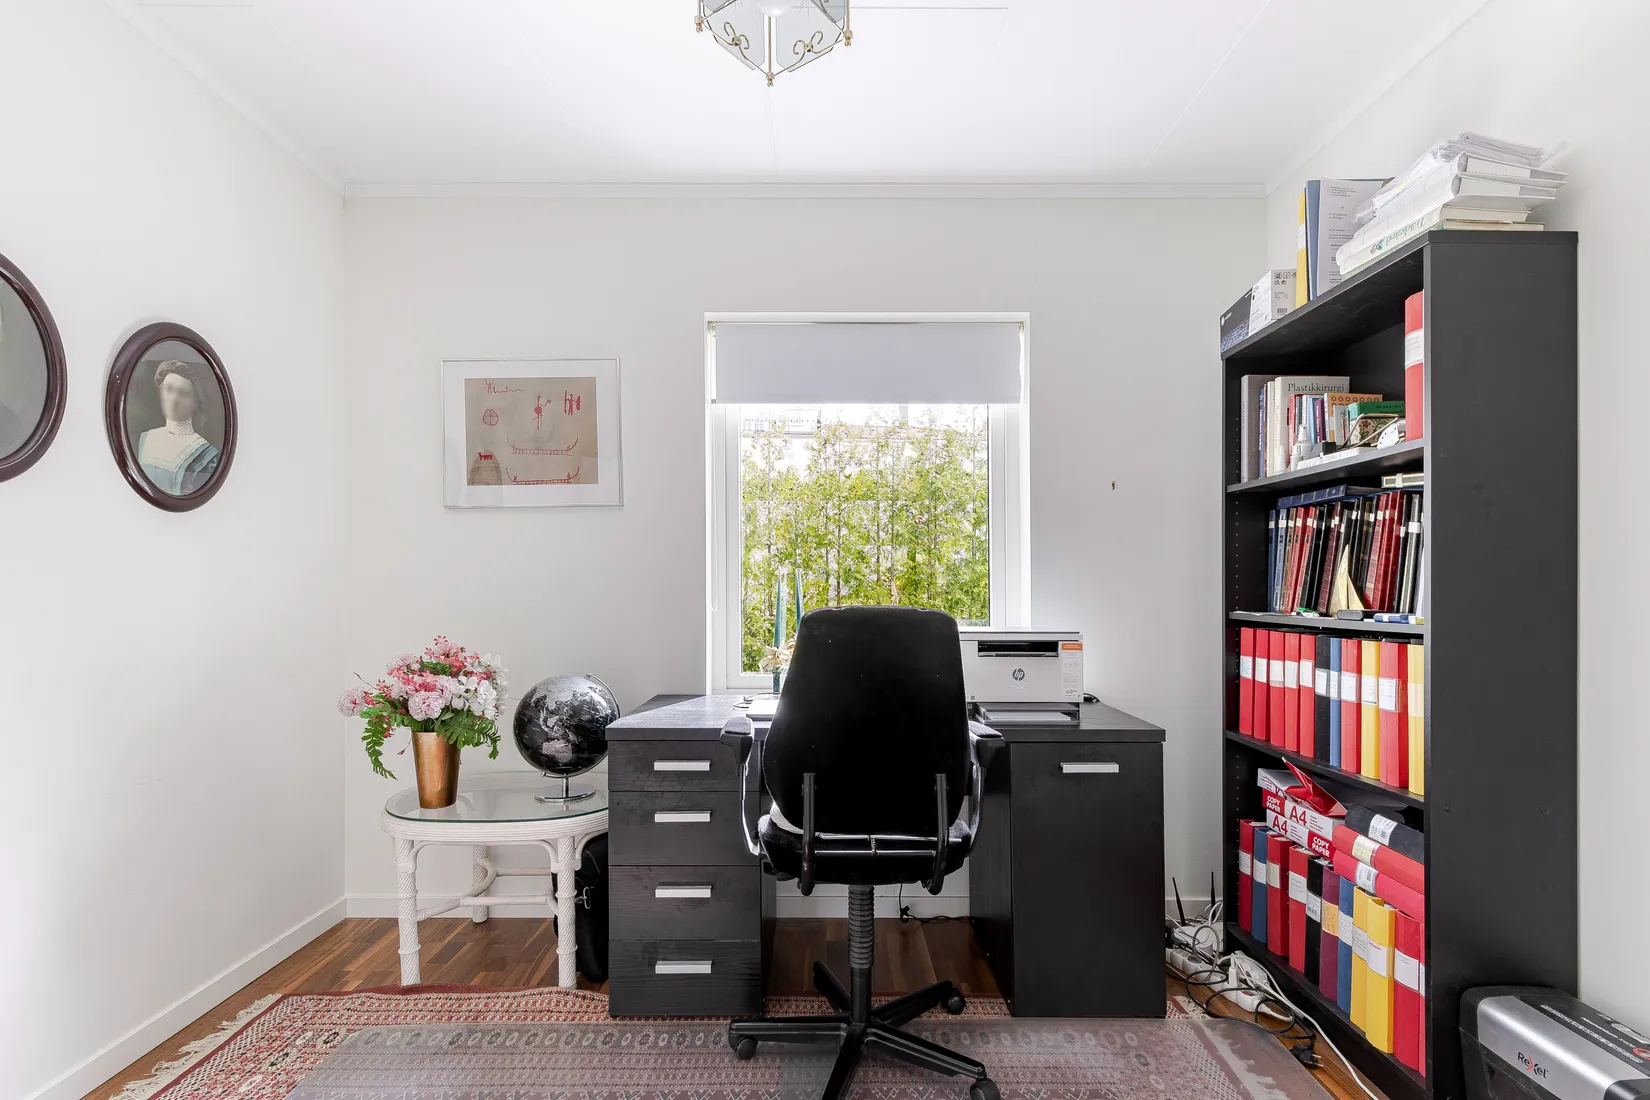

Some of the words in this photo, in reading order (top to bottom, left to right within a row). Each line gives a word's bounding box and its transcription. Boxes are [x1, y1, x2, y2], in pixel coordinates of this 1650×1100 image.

[1287, 382, 1345, 393] Plastikkirurgi
[1012, 668, 1025, 681] hp
[1266, 795, 1281, 806] COPY
[1266, 800, 1281, 814] PAPER
[1290, 806, 1308, 827] A4
[1272, 815, 1288, 836] A4
[1311, 842, 1330, 858] PAPER
[1313, 836, 1330, 850] COPY
